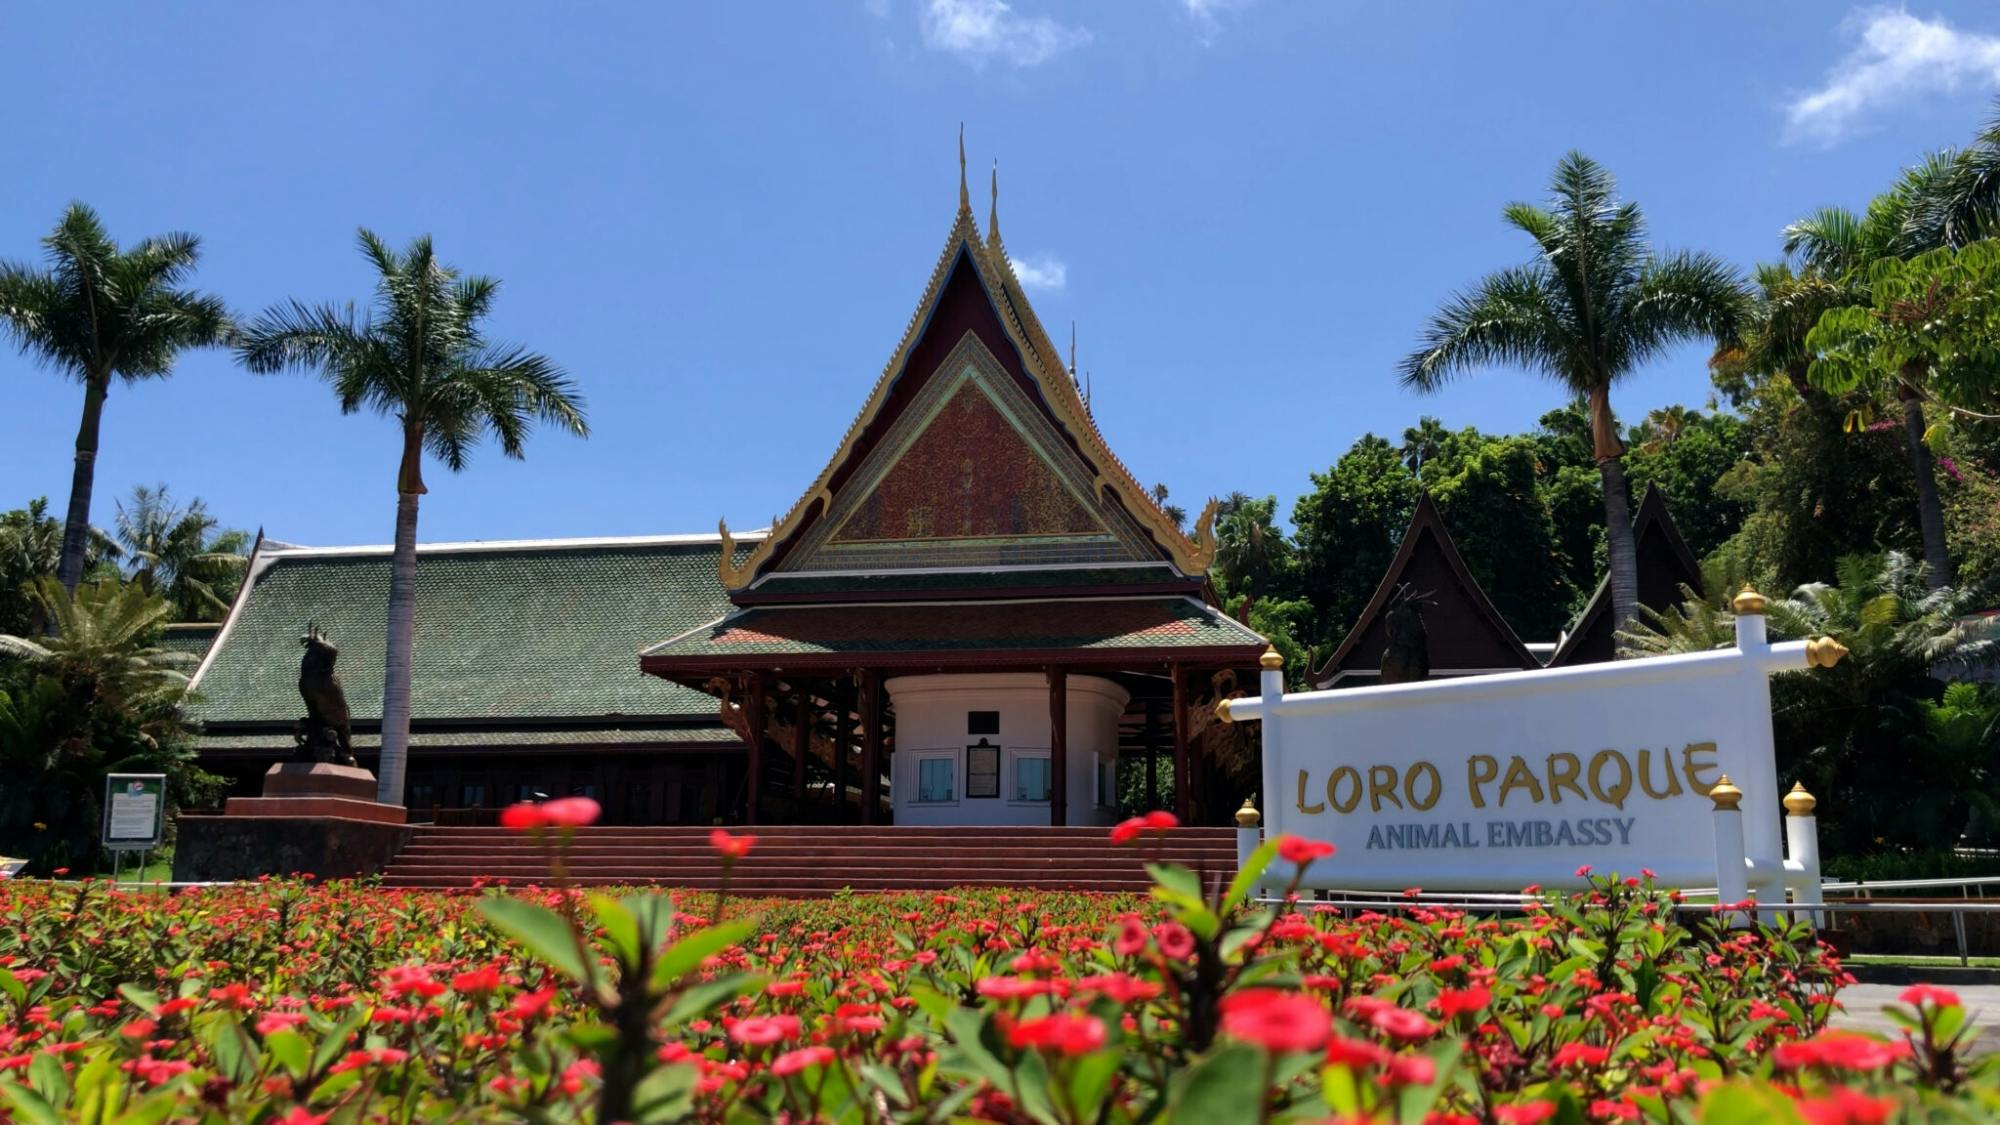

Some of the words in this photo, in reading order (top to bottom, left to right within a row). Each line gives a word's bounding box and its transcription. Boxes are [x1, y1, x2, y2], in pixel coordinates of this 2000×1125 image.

[1296, 761, 1442, 815] LORO
[1466, 742, 1719, 810] PARQUE
[1366, 822, 1479, 850] ANIMAL
[1487, 817, 1636, 849] EMBASSY
